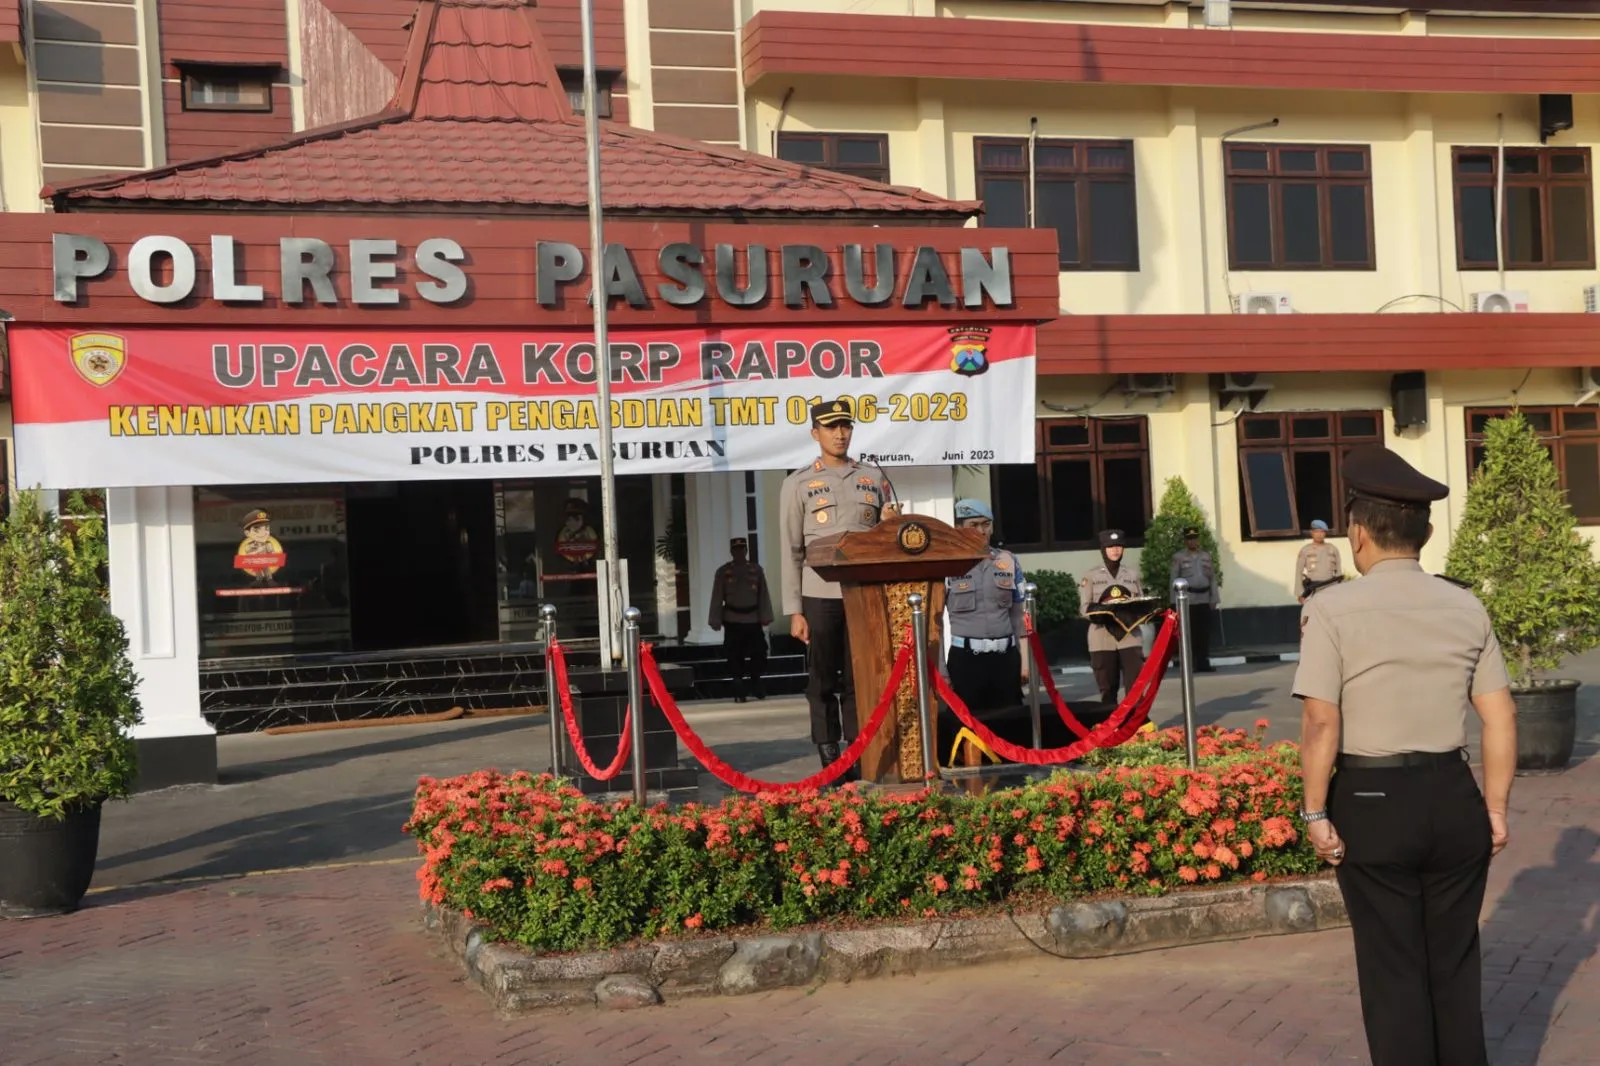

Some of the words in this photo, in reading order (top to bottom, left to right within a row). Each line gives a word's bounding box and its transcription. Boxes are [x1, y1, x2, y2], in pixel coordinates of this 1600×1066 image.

[52, 233, 467, 304] POLRES
[536, 240, 1012, 306] PASURUAN
[212, 343, 505, 388] UPACARA
[523, 341, 680, 385] KORP
[700, 340, 885, 380] RAPOR
[108, 404, 300, 437] KENAIKAN
[310, 401, 478, 434] PANGKAT
[486, 397, 703, 431] PENGABDIAN
[709, 396, 779, 427] TMT
[410, 444, 545, 465] POLRES
[942, 450, 964, 461] Juni
[970, 450, 994, 460] 2023
[807, 486, 831, 498] BAYU
